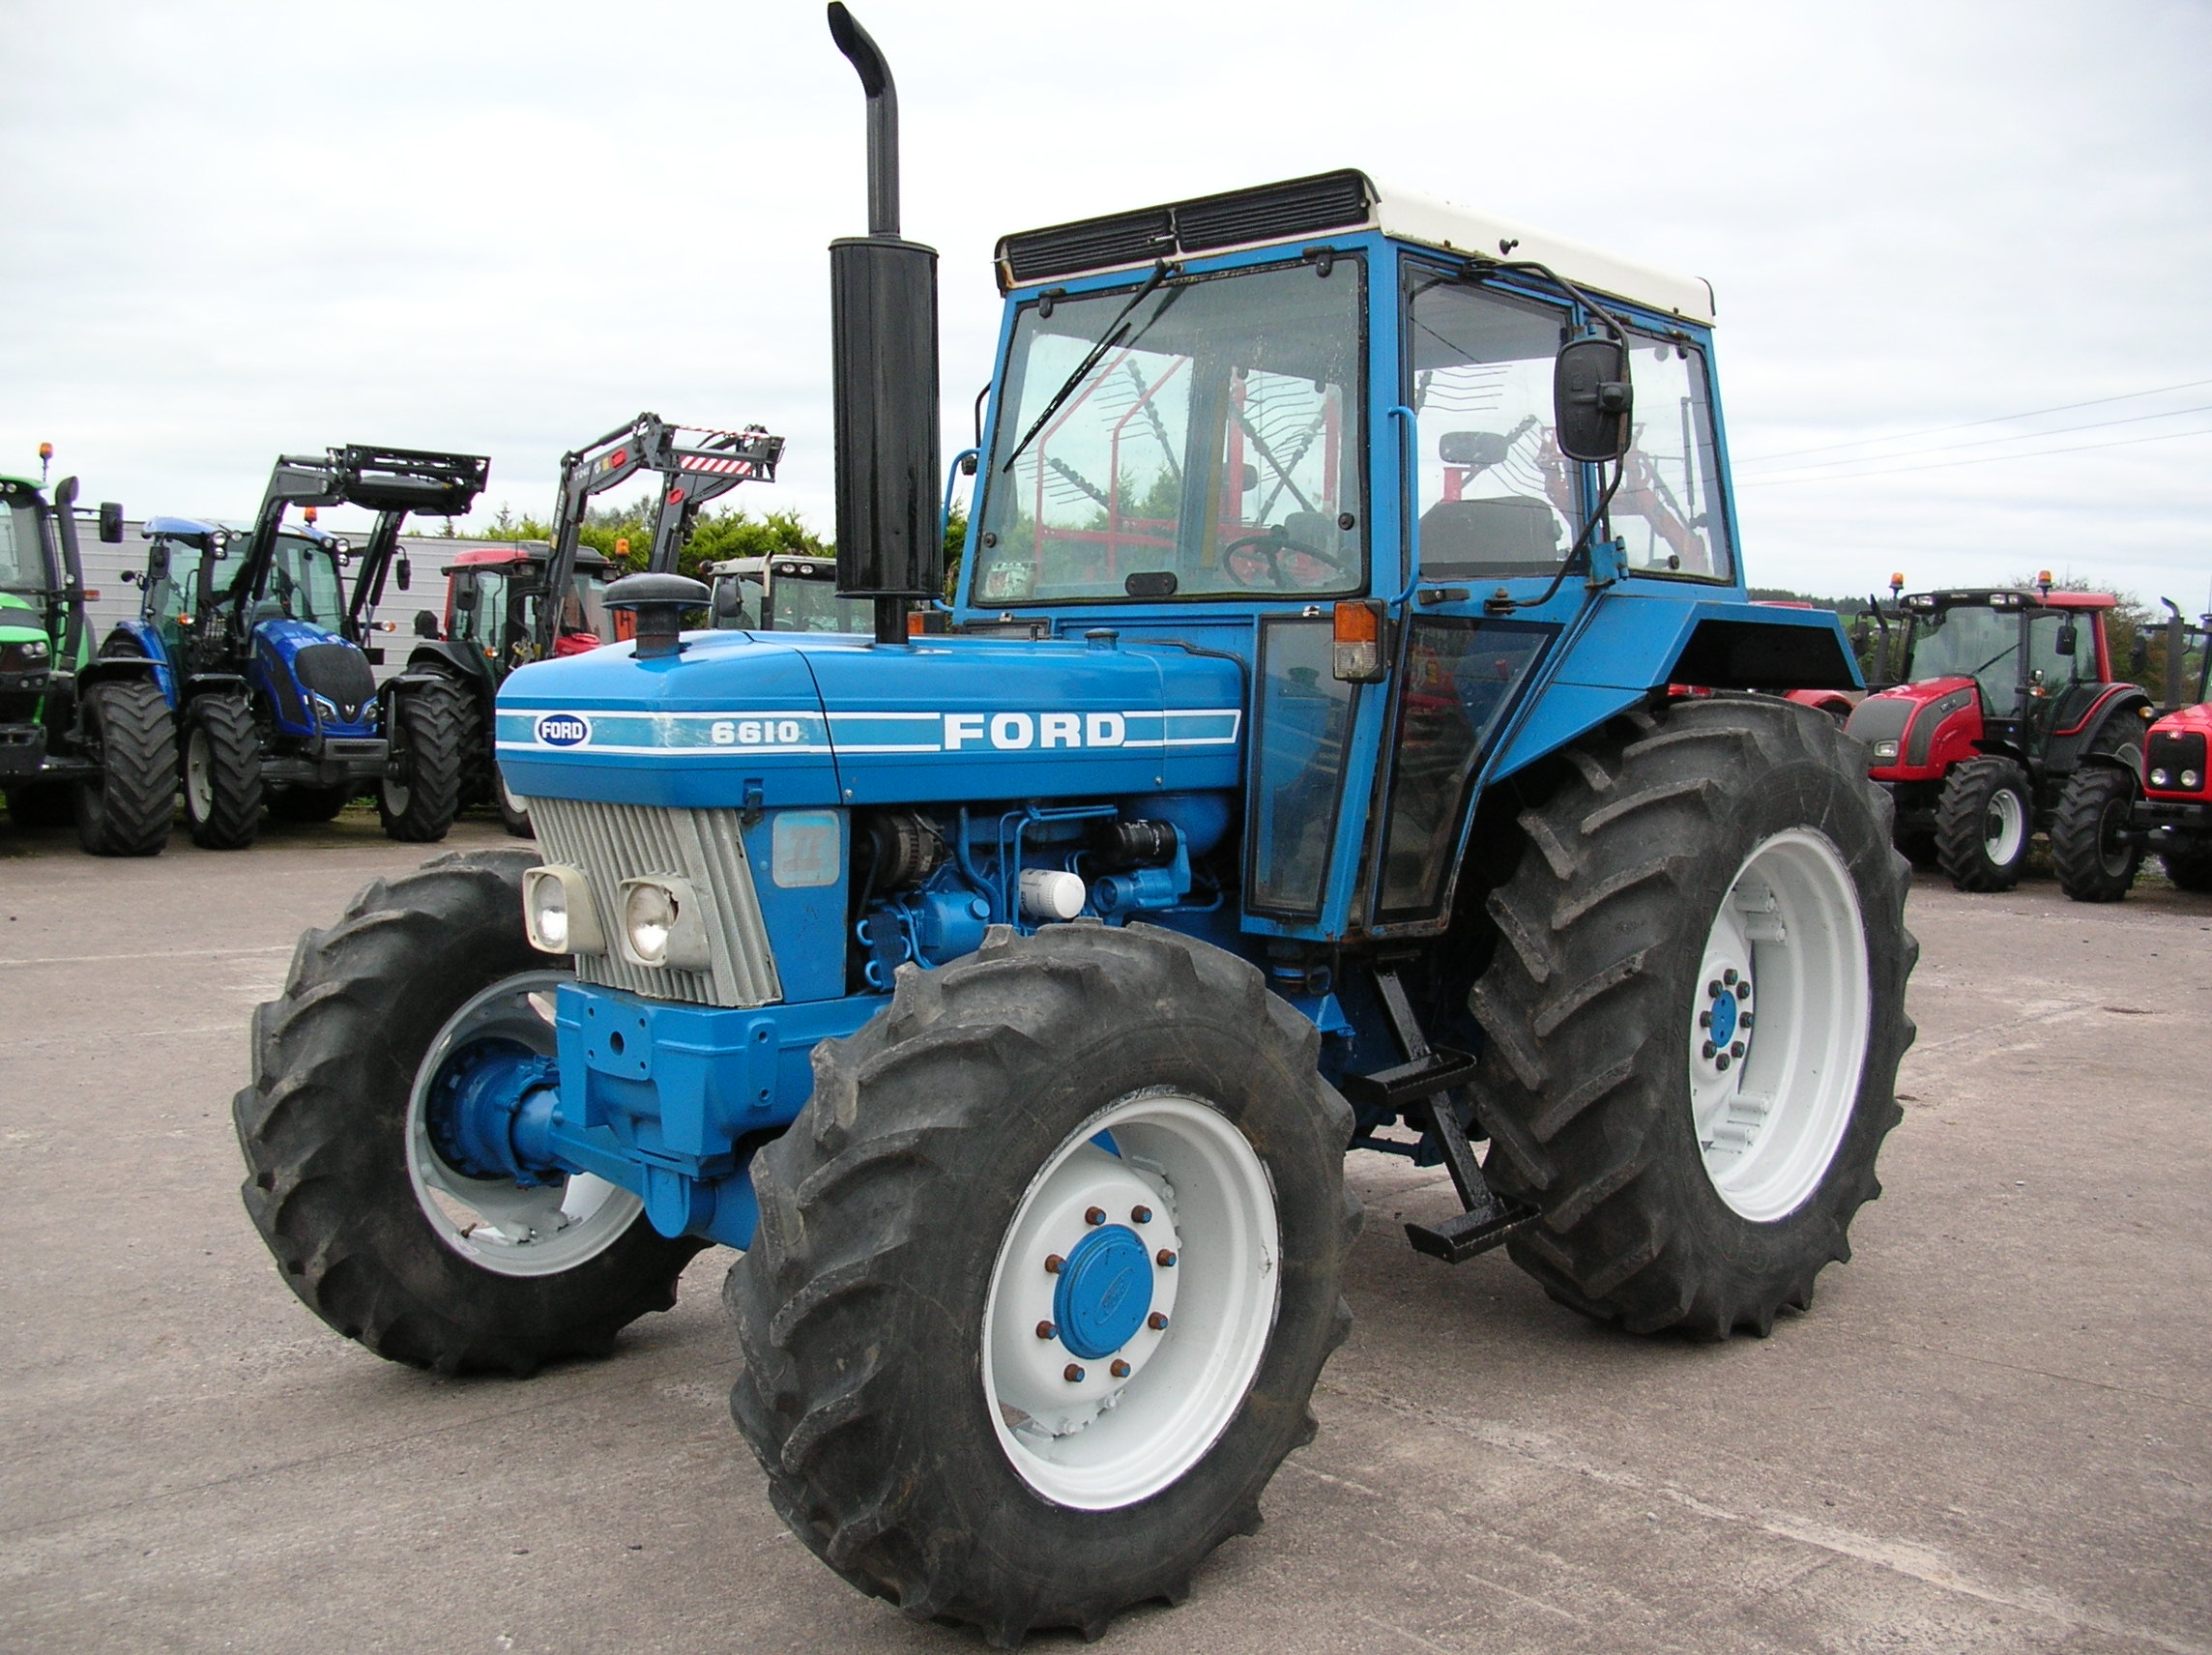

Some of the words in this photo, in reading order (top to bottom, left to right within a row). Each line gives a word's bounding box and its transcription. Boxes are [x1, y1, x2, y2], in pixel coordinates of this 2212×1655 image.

[541, 721, 583, 740] FORD
[711, 721, 800, 744] 6610
[944, 712, 1125, 749] FORD
